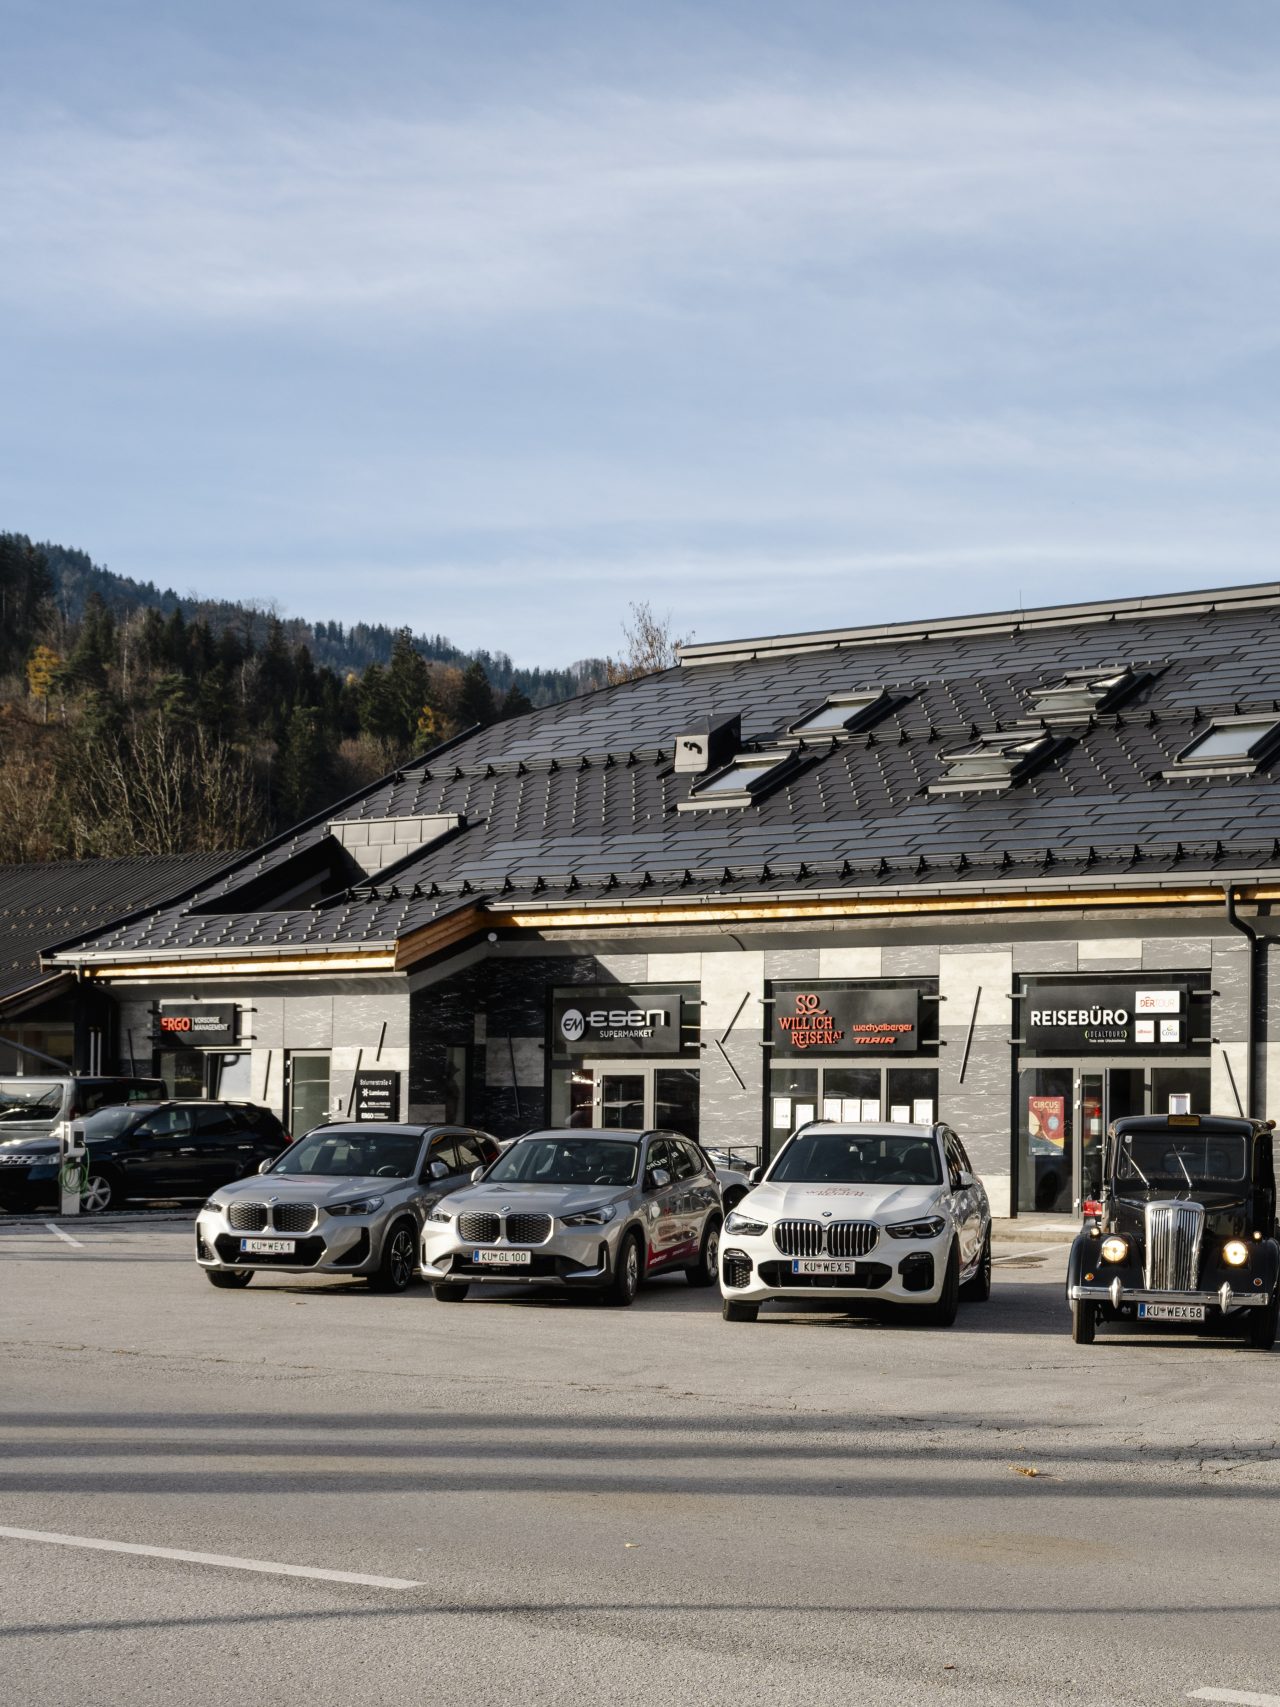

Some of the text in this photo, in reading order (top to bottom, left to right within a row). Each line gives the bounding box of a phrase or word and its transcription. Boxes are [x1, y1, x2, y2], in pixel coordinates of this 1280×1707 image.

[795, 994, 827, 1015] SO
[1030, 1005, 1129, 1026] REISEBÜRO
[160, 1017, 190, 1031] ERGO
[778, 1016, 833, 1030] WILL ICH
[599, 1029, 654, 1038] SUPERMARKET
[1033, 1101, 1060, 1110] CIRCUS
[268, 1242, 284, 1251] WEX
[481, 1252, 527, 1262] KU GL 100
[803, 1262, 816, 1272] KU
[822, 1262, 842, 1272] WEX
[1146, 1305, 1202, 1318] KU WEX 58
